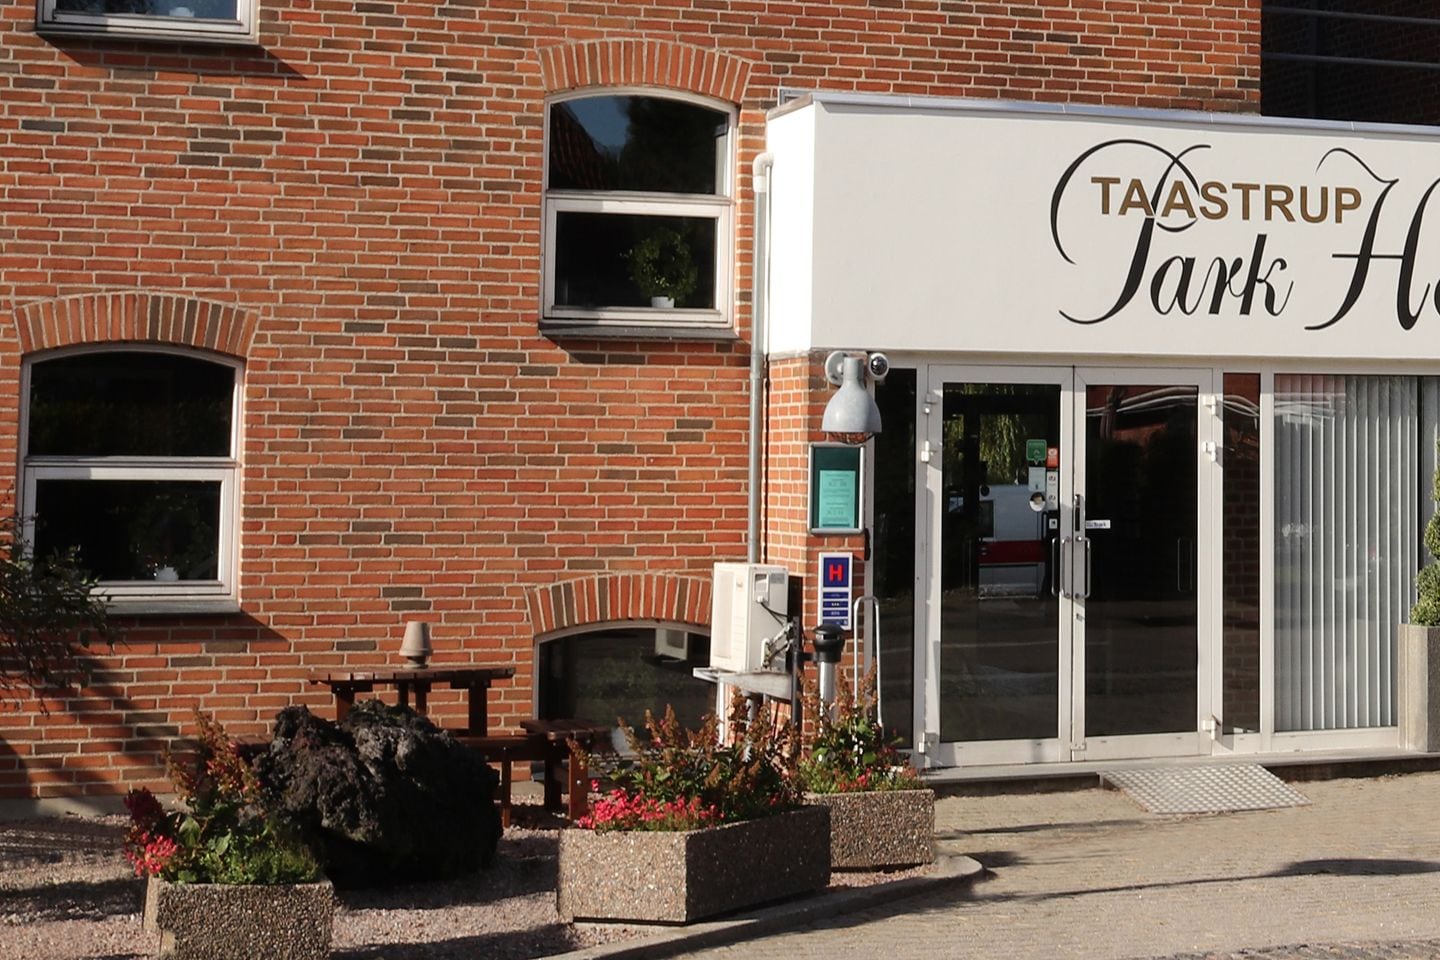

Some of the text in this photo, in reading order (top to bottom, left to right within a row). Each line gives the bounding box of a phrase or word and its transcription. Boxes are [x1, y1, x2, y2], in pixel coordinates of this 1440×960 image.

[1091, 177, 1362, 224] TAASTRUP
[1051, 139, 1294, 326] Park
[829, 564, 843, 582] H
